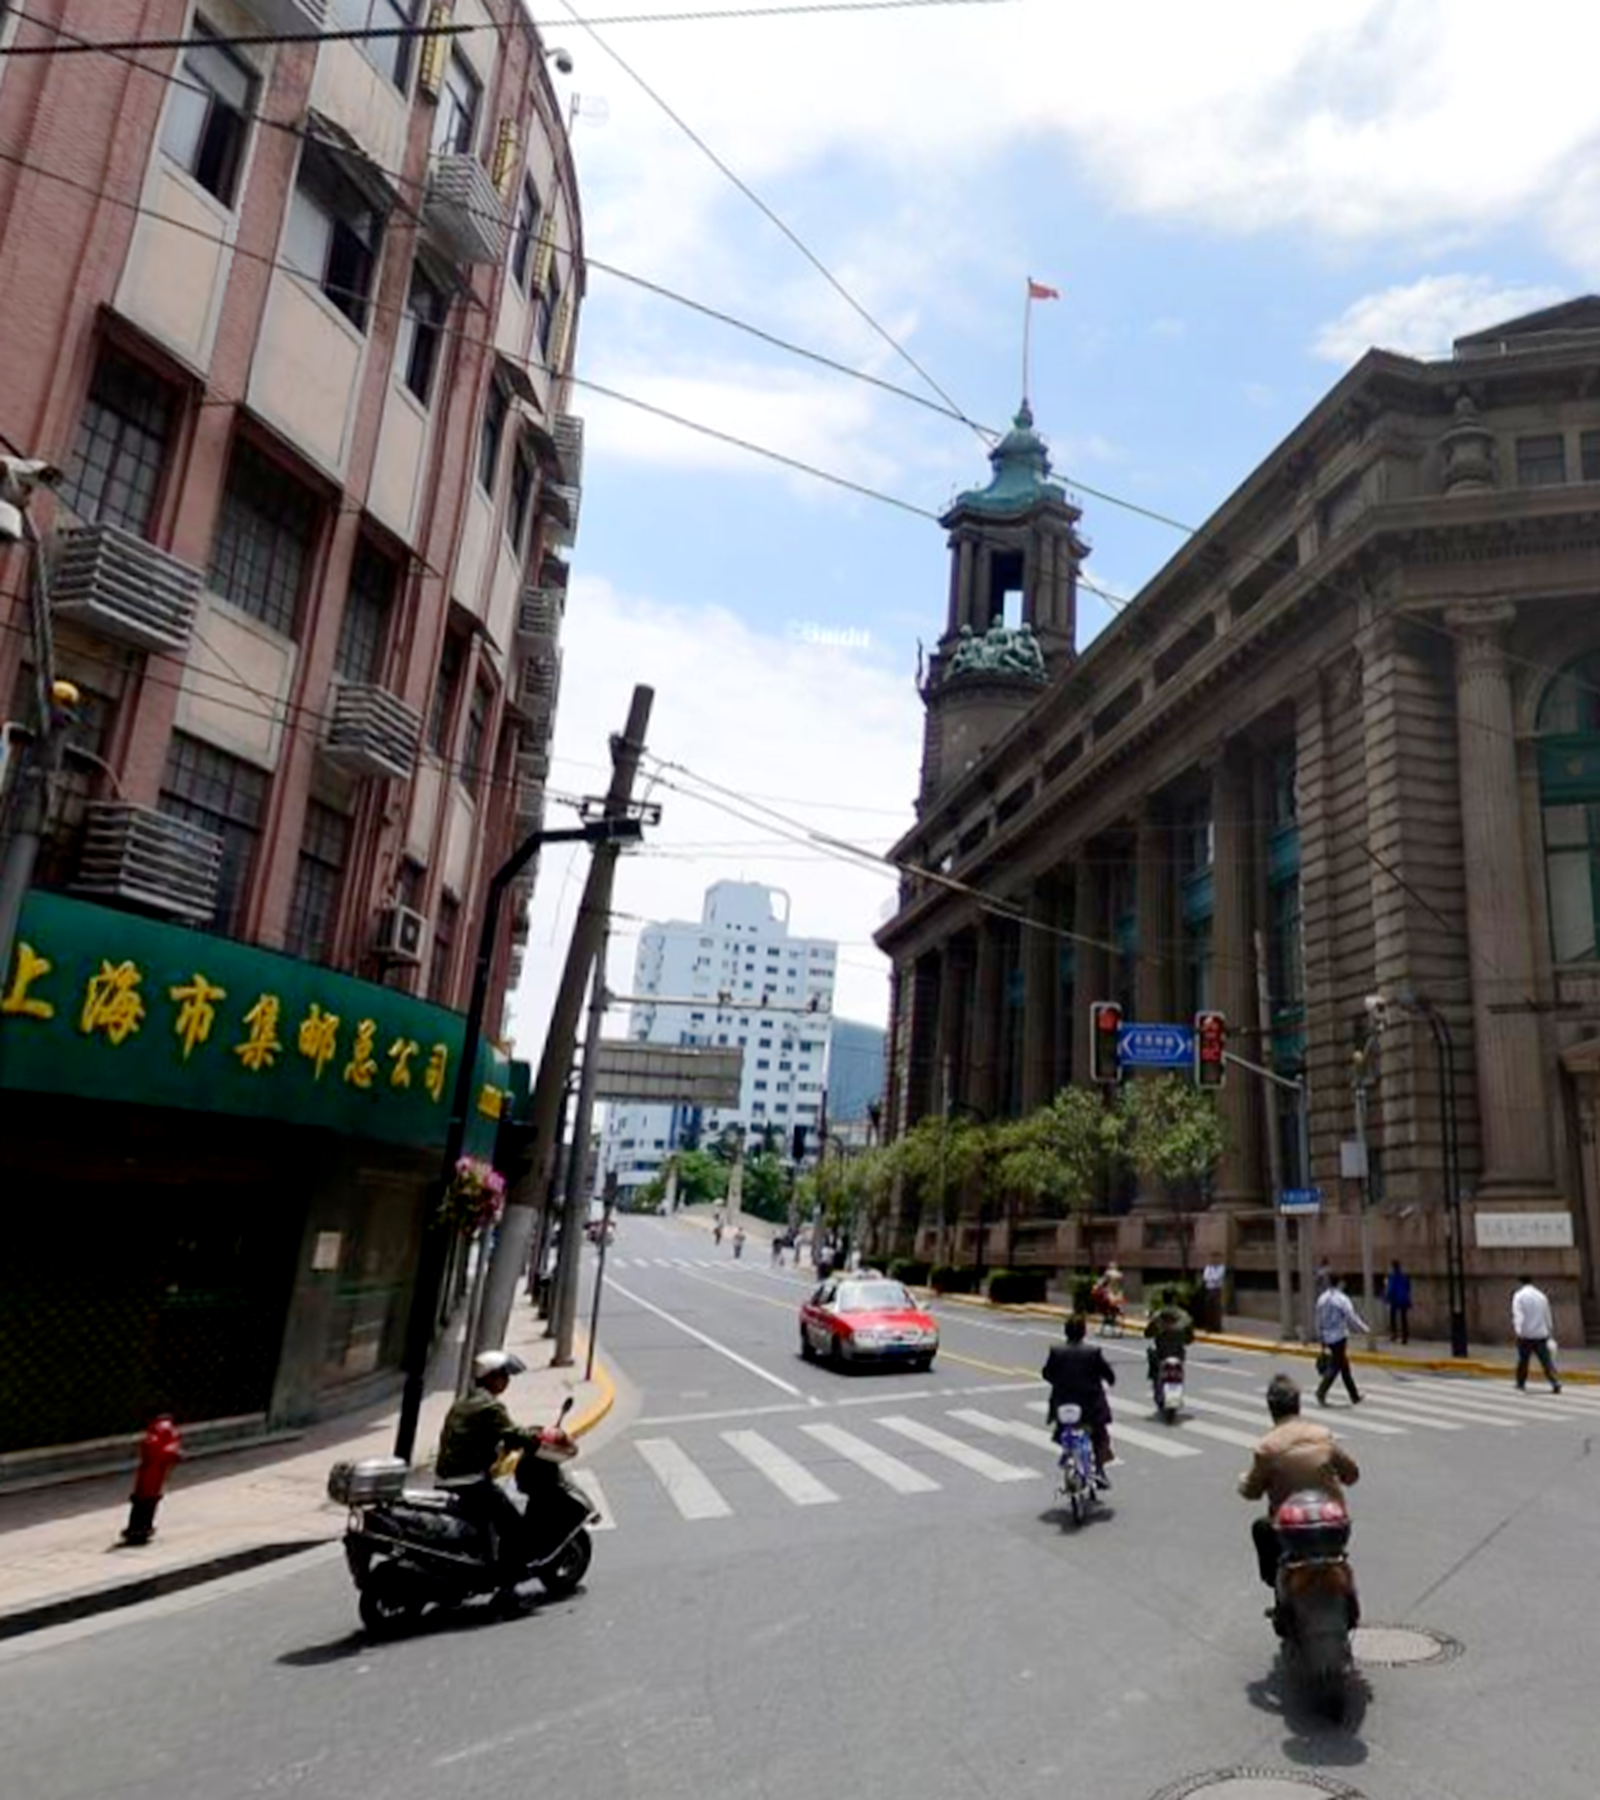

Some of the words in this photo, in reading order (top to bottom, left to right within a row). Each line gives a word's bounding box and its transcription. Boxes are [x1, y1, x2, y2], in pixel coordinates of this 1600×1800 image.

[2, 941, 449, 1102] 上海市集邮总公司
